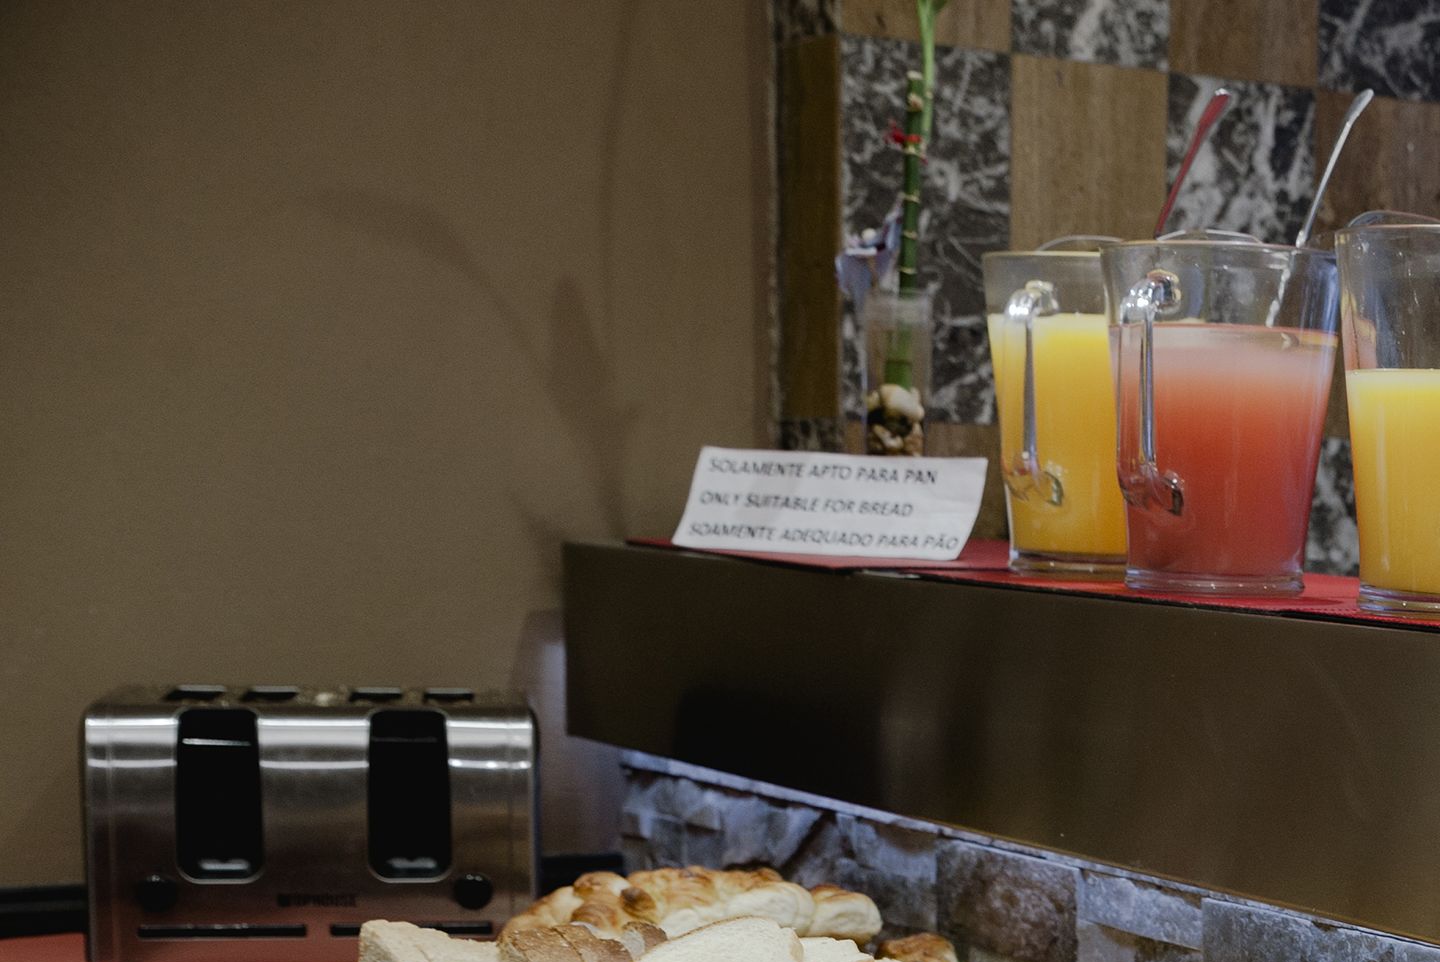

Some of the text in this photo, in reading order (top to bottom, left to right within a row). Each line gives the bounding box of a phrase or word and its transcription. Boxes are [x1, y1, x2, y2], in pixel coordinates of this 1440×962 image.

[808, 463, 852, 481] APTO
[856, 467, 899, 483] PARA
[903, 469, 938, 485] PAN
[699, 489, 914, 518] ONLY SUITABLE FOR BREAD
[780, 528, 874, 548] ADEQUADO
[877, 533, 918, 549] PARA
[921, 531, 960, 551] PÃO
